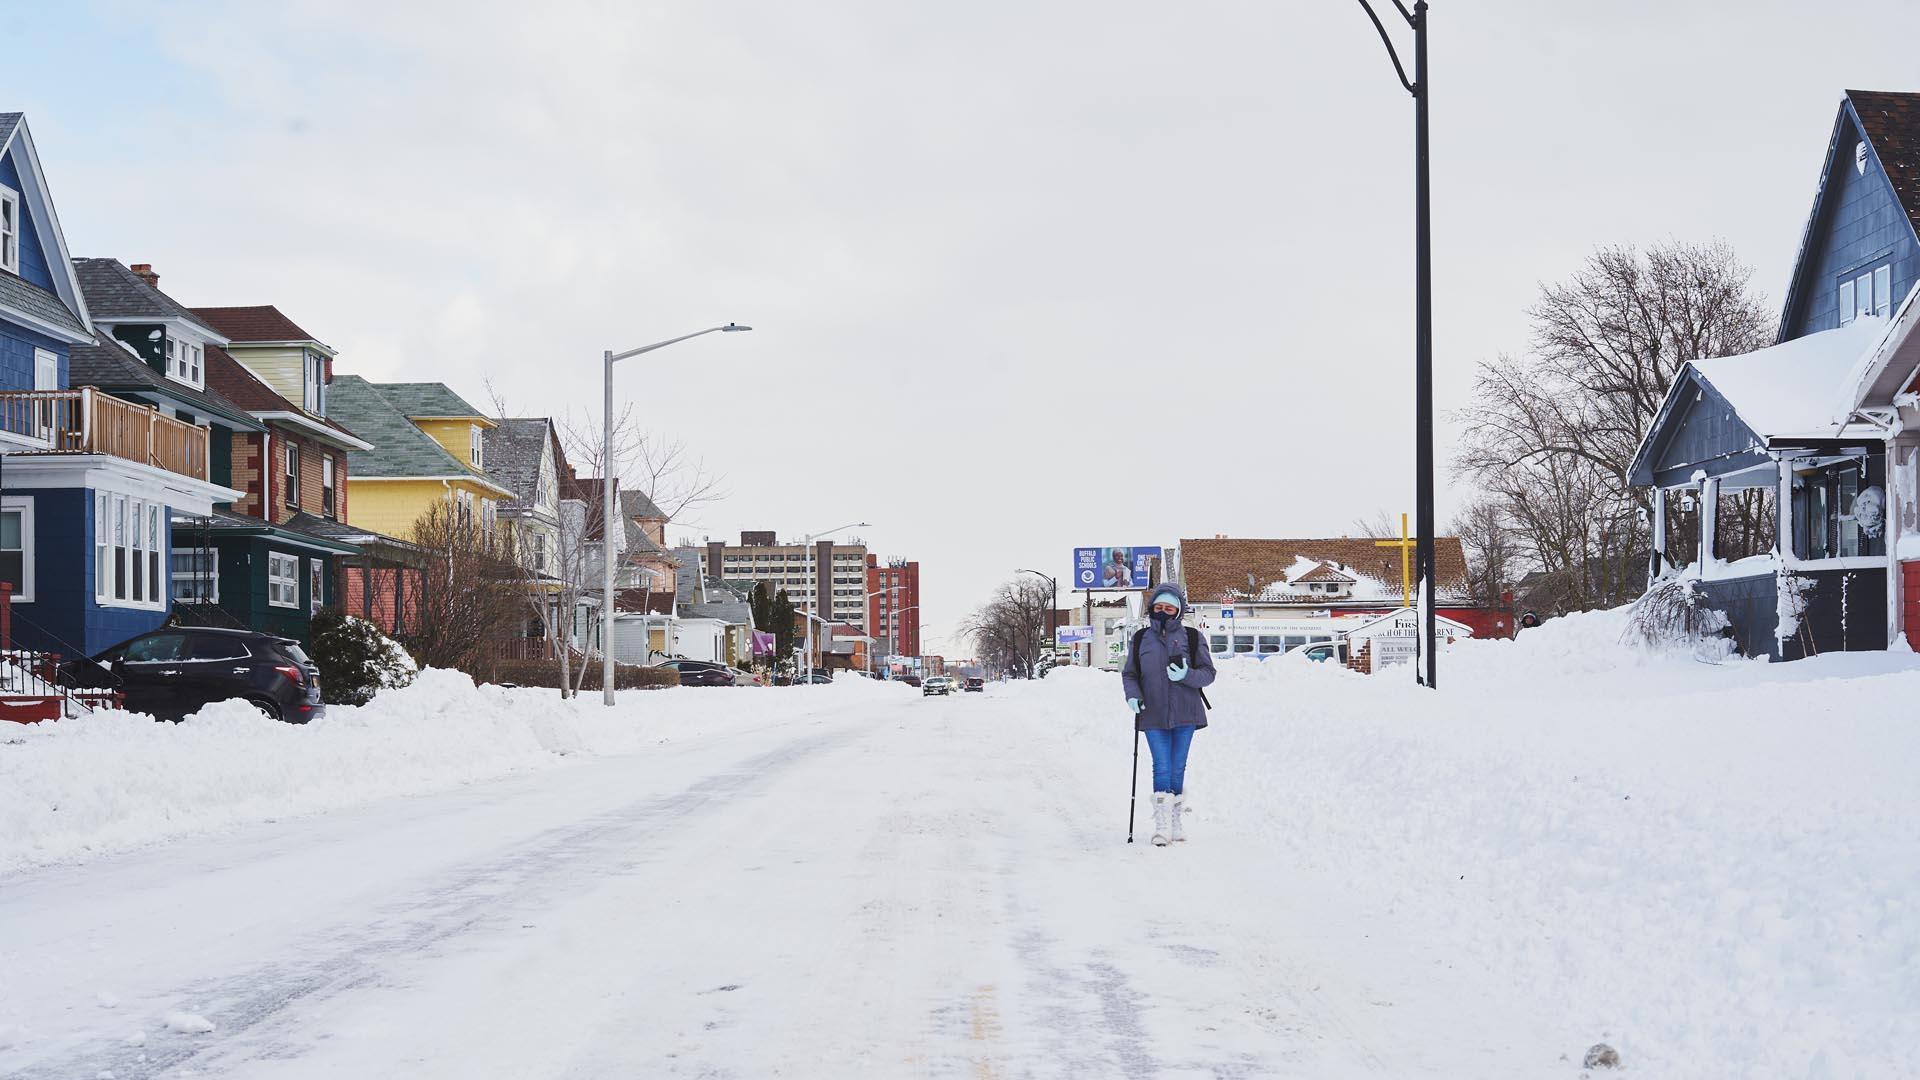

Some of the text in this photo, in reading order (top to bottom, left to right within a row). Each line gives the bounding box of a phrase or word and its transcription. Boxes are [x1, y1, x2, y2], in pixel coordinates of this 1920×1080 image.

[1395, 619, 1417, 628] FIRS
[1074, 629, 1091, 637] WASH
[1393, 629, 1402, 637] OF
[1073, 651, 1080, 659] 6
